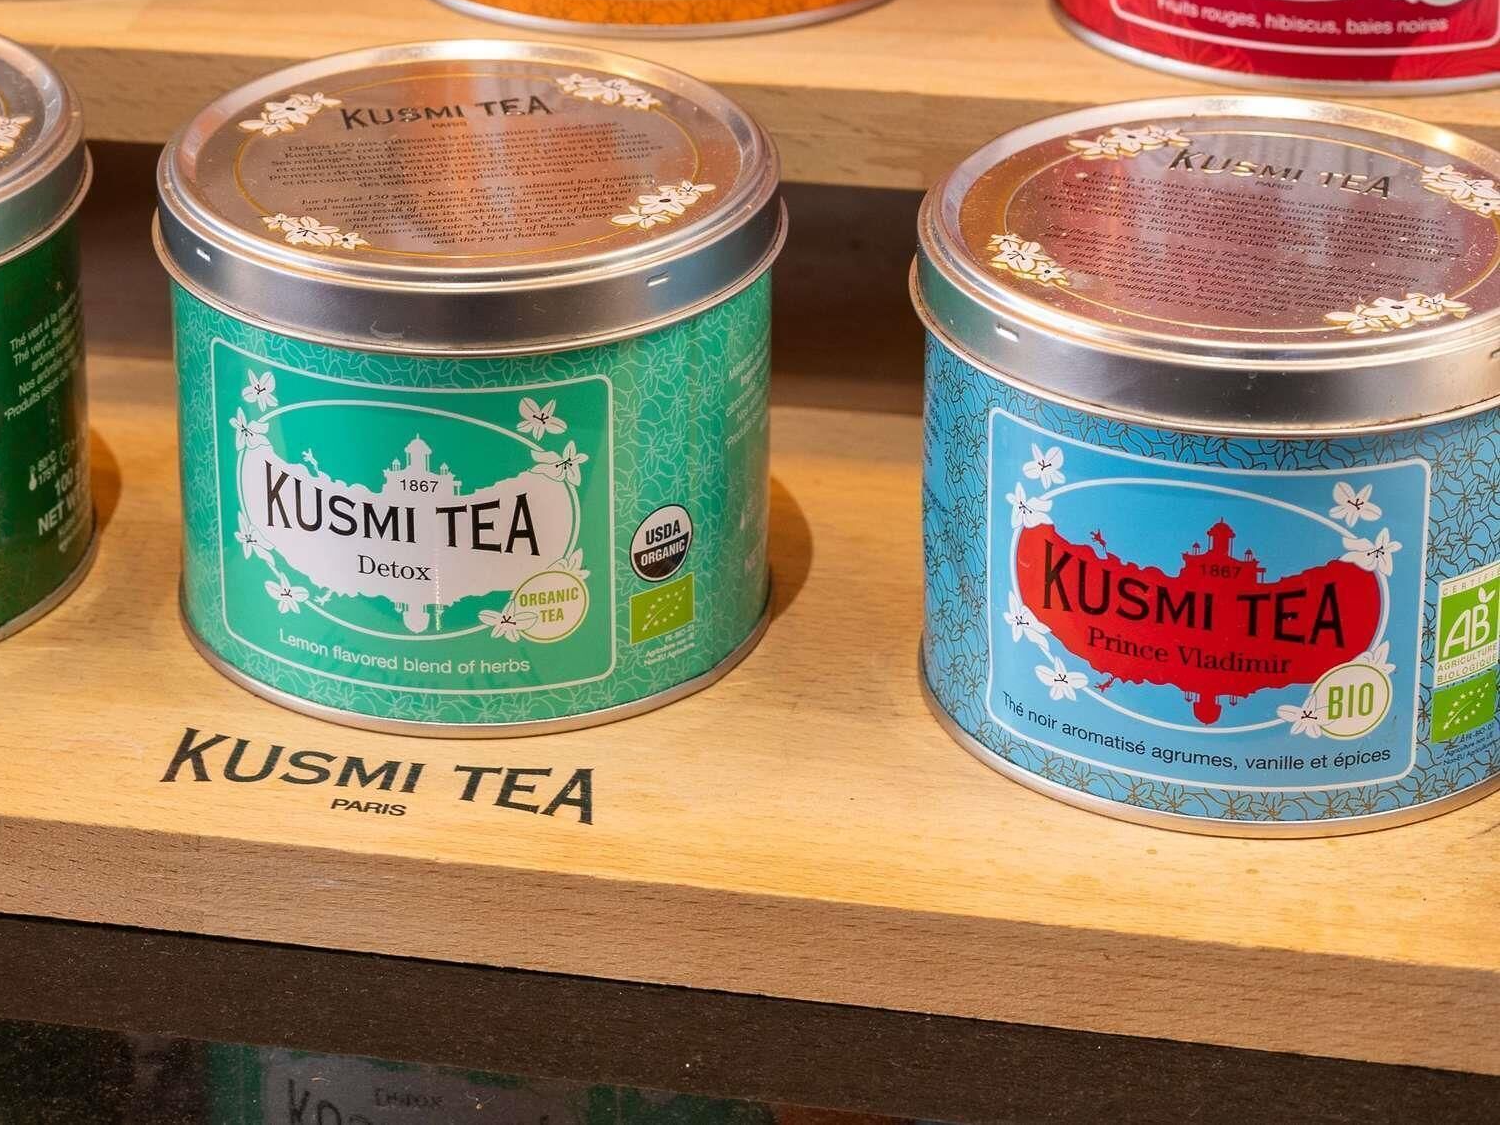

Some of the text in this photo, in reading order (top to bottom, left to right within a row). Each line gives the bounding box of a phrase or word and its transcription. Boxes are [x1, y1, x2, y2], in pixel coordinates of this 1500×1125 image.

[1201, 3, 1261, 29] rouges,
[1265, 12, 1341, 34] hibiscus,
[1346, 18, 1392, 34] baies
[1396, 17, 1448, 33] noires
[340, 95, 556, 131] KUSMI TEA
[1169, 148, 1390, 199] KUSMI TEA
[10, 333, 26, 351] Thé
[13, 347, 30, 367] Thé
[18, 379, 35, 396] Nos
[400, 479, 439, 493] 1867
[38, 500, 64, 535] NET
[264, 460, 540, 557] KUSMI TEA
[645, 519, 680, 545] USDA
[640, 539, 685, 567] ORGANIC
[358, 555, 432, 581] Detox
[1200, 565, 1242, 579] 1867
[520, 587, 579, 607] ORGANIC
[1042, 539, 1345, 649] KUSMI TEA
[539, 607, 564, 623] TEA
[1442, 603, 1491, 658] AB
[279, 629, 530, 675] Lemon flavored blend of herbs
[1088, 626, 1292, 674] Prince Vladimir
[1437, 643, 1498, 672] AGRICULTURE
[1437, 655, 1498, 683] BIOLOGIQUE
[1328, 681, 1374, 721] BIO
[1002, 691, 1390, 771] Thé noir aromatisé agrumes, vanille et épices
[158, 727, 596, 826] KUSMI TEA
[330, 798, 406, 817] PARIS
